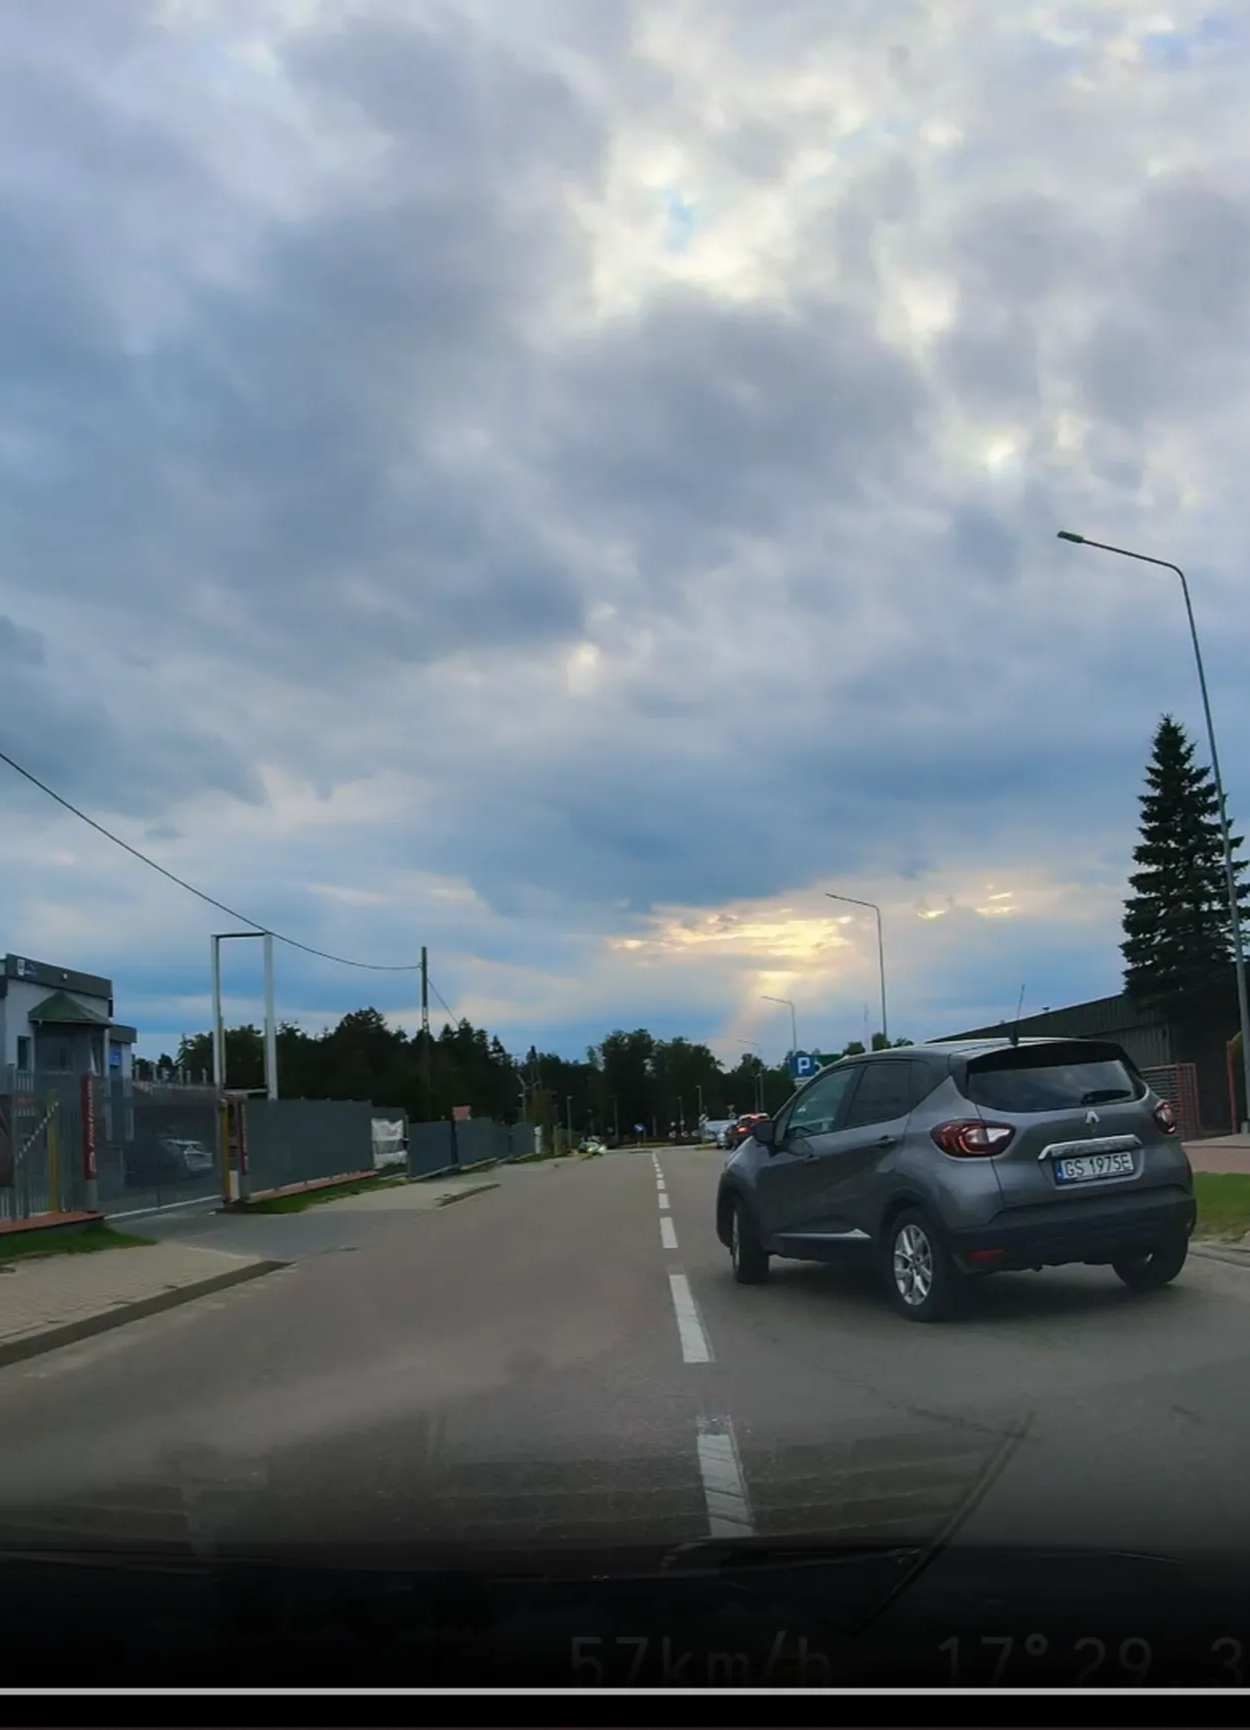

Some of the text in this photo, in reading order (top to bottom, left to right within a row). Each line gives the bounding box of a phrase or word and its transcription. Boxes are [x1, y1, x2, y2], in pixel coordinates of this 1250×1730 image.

[797, 1056, 811, 1074] P
[1065, 1153, 1130, 1177] GS 1975E
